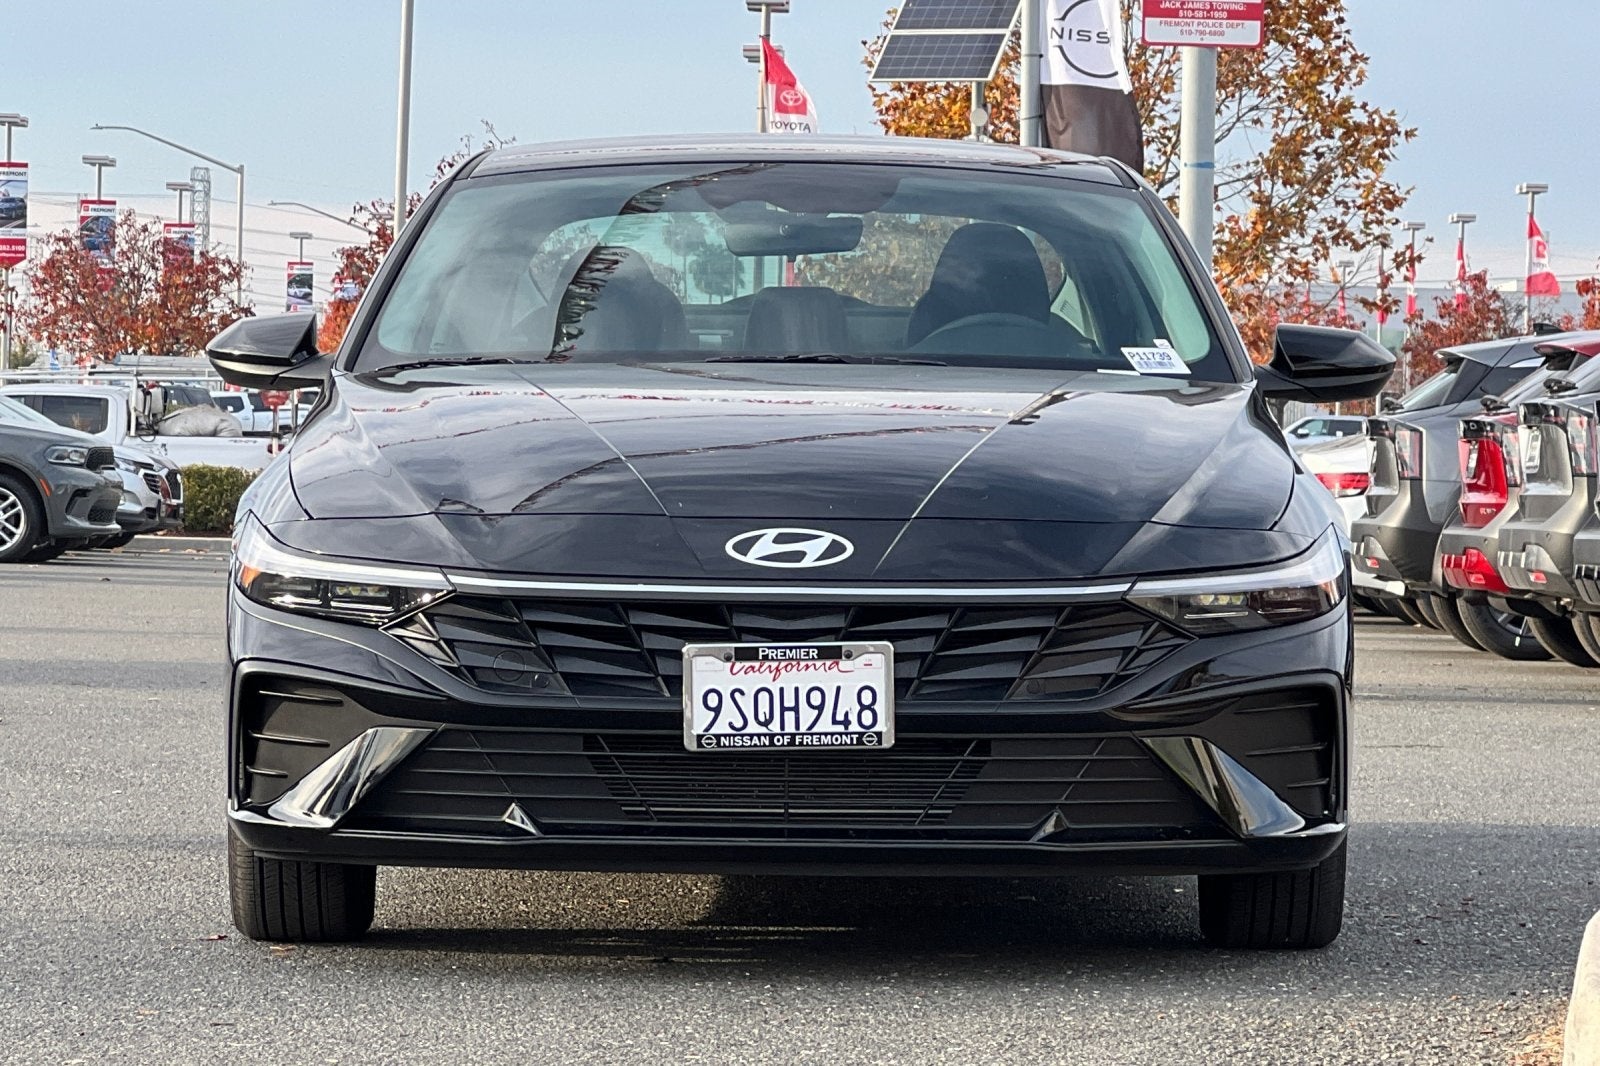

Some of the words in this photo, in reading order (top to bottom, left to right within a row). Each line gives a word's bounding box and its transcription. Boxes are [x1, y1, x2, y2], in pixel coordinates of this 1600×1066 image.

[1159, 0, 1183, 9] JACK
[1183, 1, 1211, 10] JAMES
[1212, 2, 1247, 11] TOWING:
[1178, 10, 1228, 19] 510-581-1950
[1159, 19, 1195, 28] FREMONT
[1196, 20, 1224, 28] POLICE
[1225, 21, 1247, 30] DEPT.
[1179, 28, 1226, 37] 510-790-6800
[770, 121, 811, 133] TOYOTA
[1127, 352, 1172, 361] P11739
[758, 647, 818, 660] PREMIER
[729, 661, 855, 682] California
[701, 684, 879, 733] 9SQH948
[720, 734, 770, 746] NISSAN
[771, 734, 791, 746] OF
[795, 734, 859, 746] FREMONT
